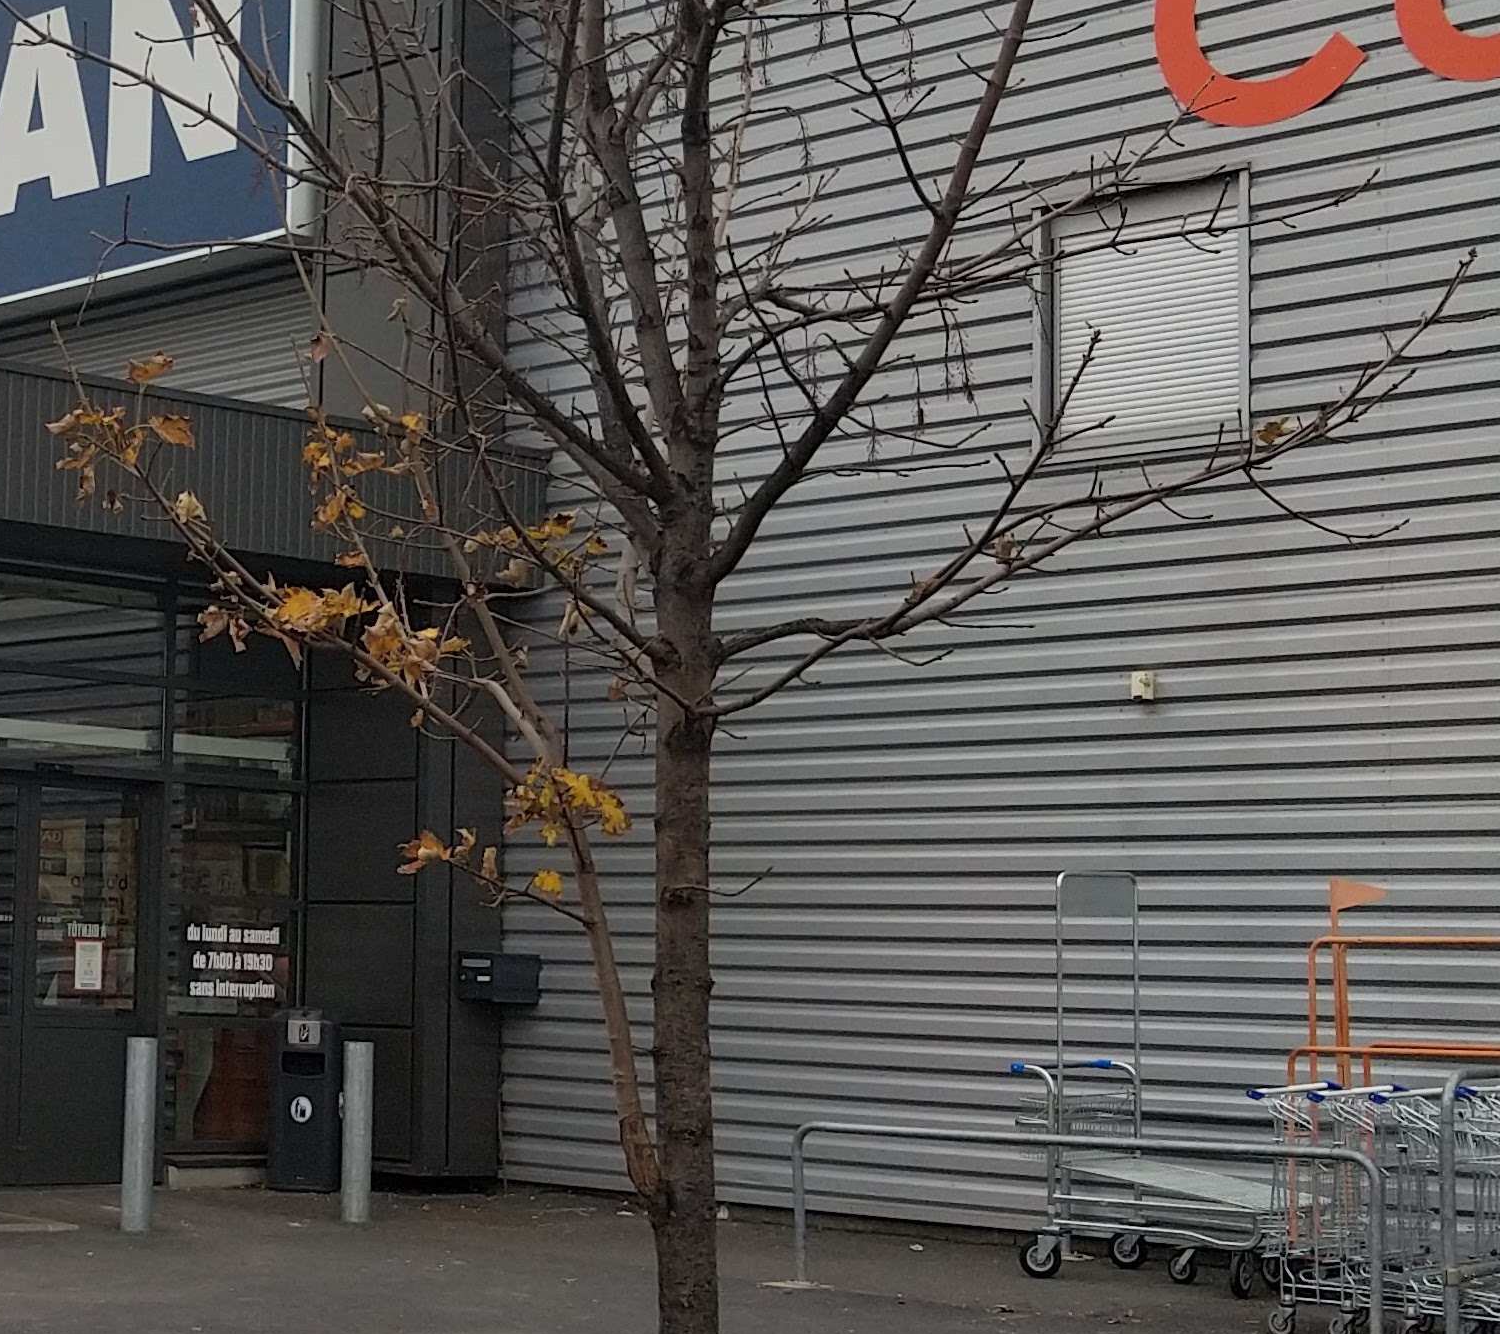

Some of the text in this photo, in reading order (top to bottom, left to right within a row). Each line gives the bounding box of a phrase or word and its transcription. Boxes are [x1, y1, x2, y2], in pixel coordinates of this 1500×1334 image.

[187, 923, 279, 944] du lundi au samedi
[193, 951, 206, 969] de
[207, 952, 233, 969] 7h00
[243, 953, 272, 971] 19h30
[190, 979, 274, 1000] sans interruption
